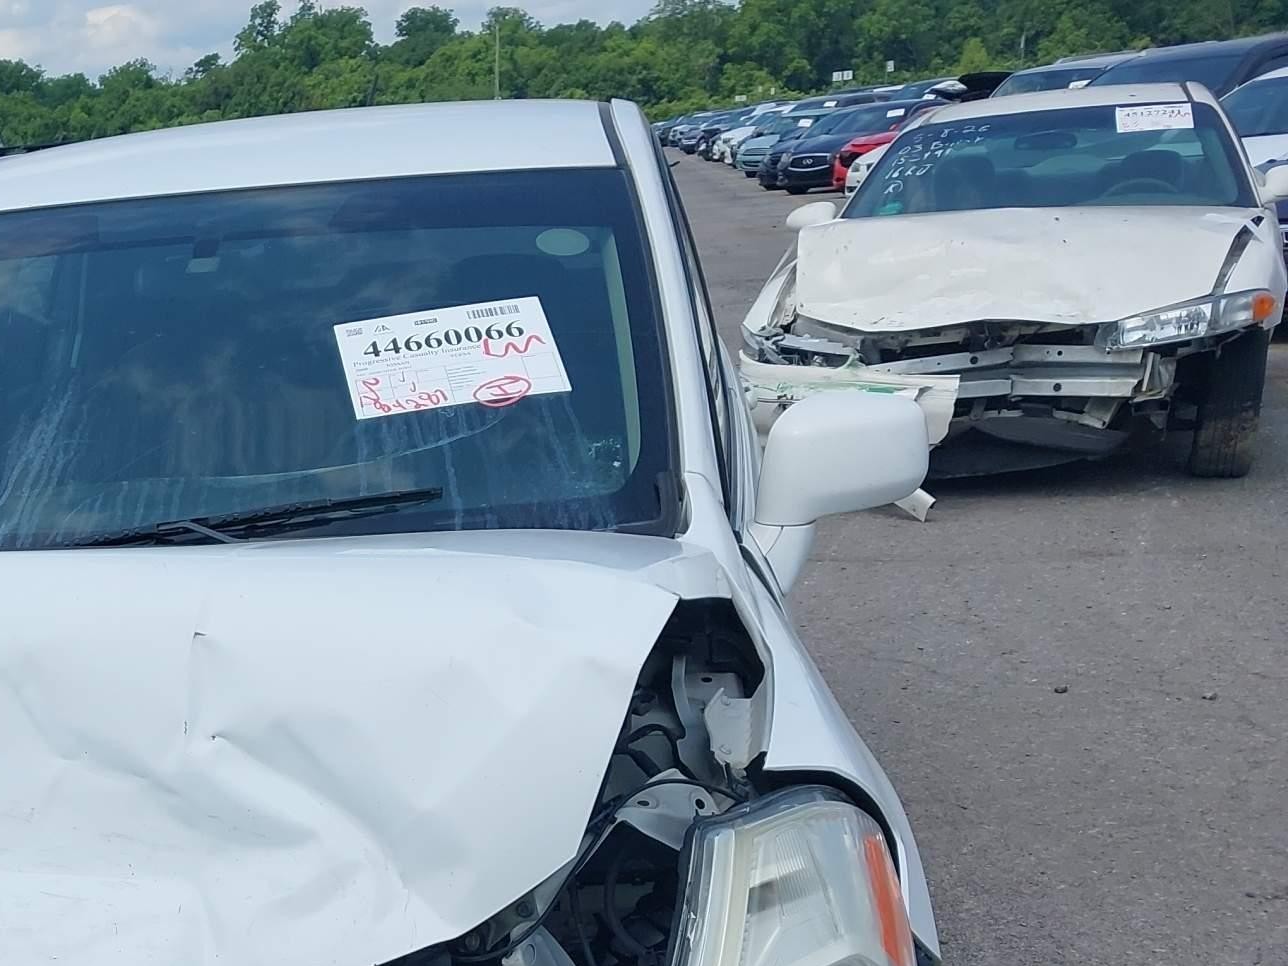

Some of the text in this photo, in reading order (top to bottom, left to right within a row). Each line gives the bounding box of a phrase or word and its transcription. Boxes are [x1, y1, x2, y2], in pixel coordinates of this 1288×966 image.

[363, 320, 525, 358] 44660066
[353, 344, 481, 368] Progressive Casualty Insurance
